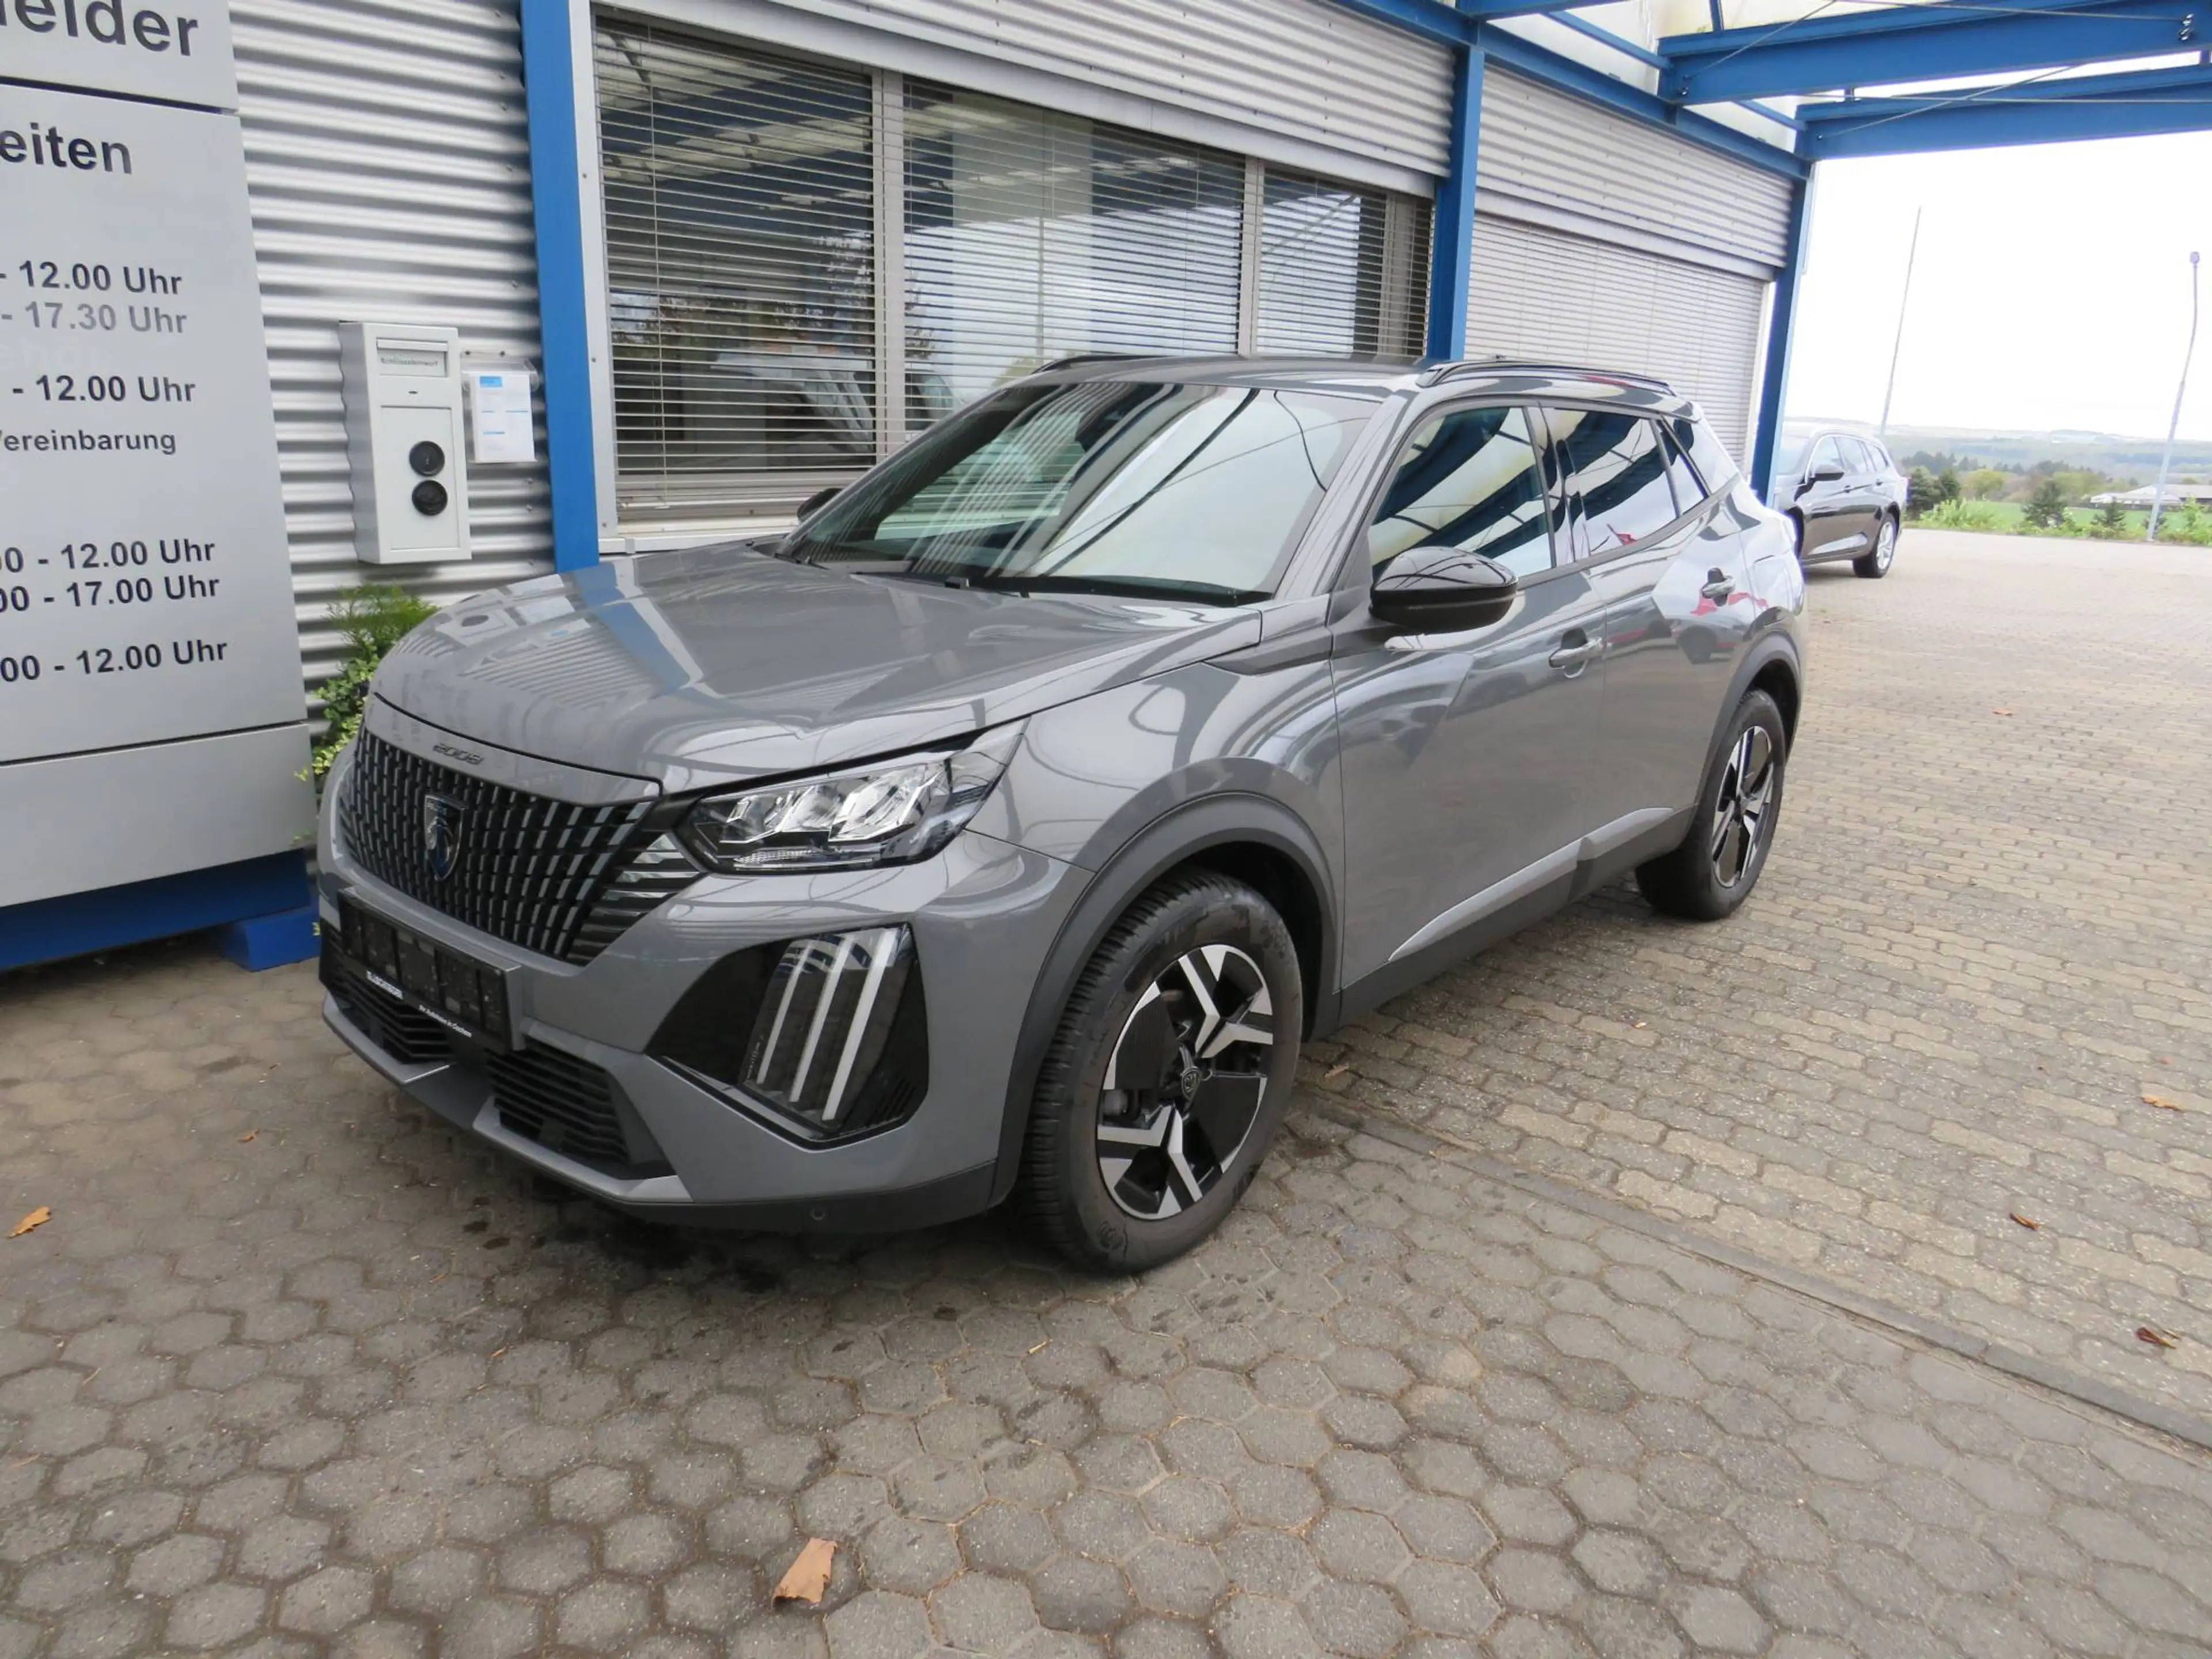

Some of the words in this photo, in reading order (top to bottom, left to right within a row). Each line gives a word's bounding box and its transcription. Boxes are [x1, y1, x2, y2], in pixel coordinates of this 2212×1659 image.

[19, 260, 111, 291] 12.00
[123, 266, 182, 295] Uhr
[25, 301, 116, 331] 17.30
[128, 305, 187, 333] Uhr
[35, 374, 126, 402] 12.00
[137, 376, 196, 402] Uhr
[0, 429, 176, 456] ereinbarung
[60, 540, 148, 570] 12.00
[159, 538, 215, 566] Uhr
[66, 575, 153, 607] 17.00
[164, 574, 220, 601] Uhr
[76, 643, 162, 675] 12.00
[172, 639, 228, 665] Uhr
